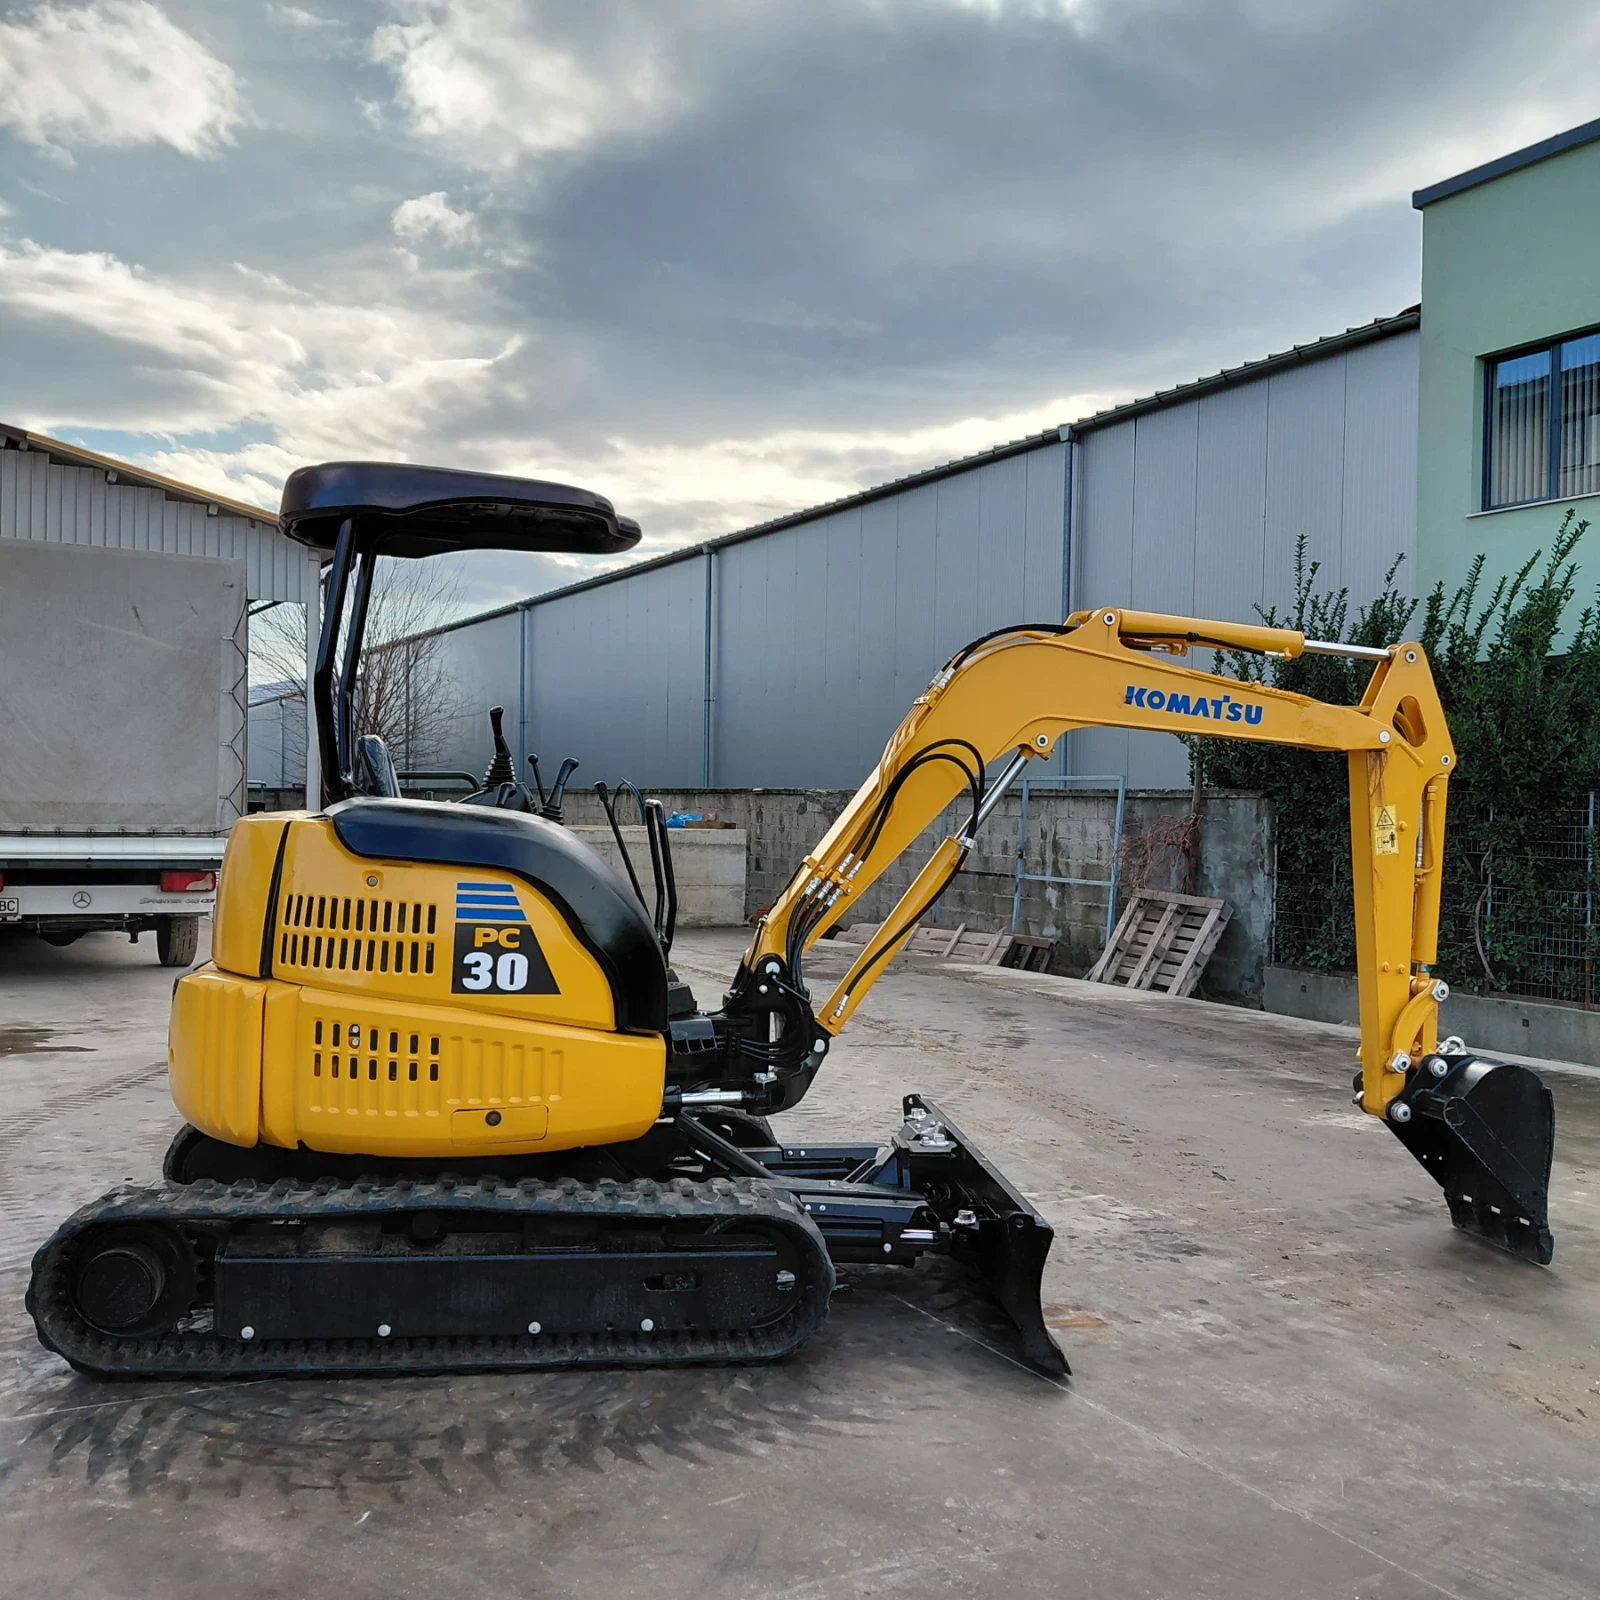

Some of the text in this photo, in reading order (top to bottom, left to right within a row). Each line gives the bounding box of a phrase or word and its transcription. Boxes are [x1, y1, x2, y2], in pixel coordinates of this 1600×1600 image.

[1125, 685, 1263, 725] KOMATSU
[474, 927, 521, 949] PC
[462, 952, 529, 991] 30
